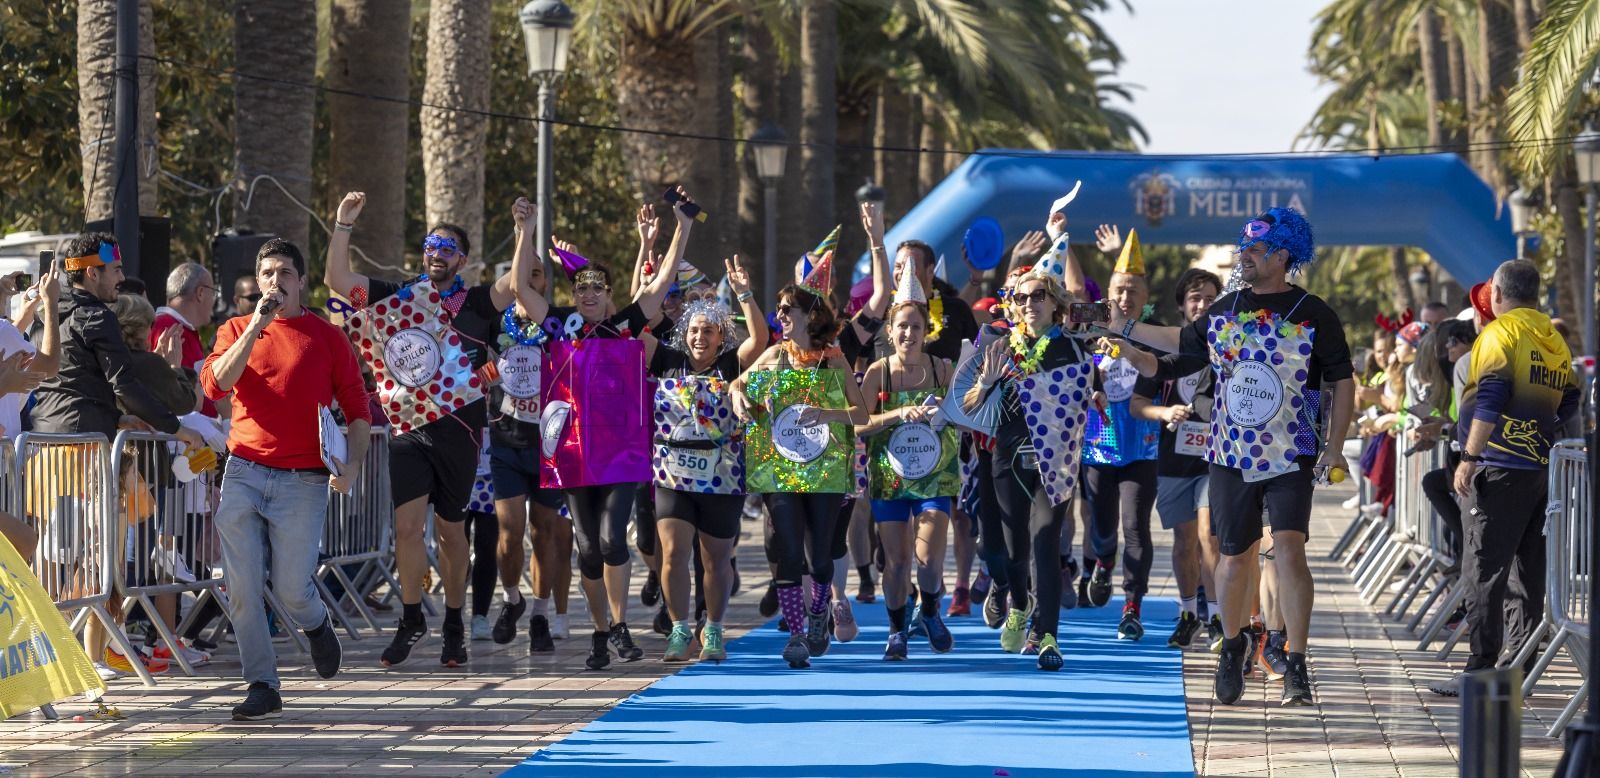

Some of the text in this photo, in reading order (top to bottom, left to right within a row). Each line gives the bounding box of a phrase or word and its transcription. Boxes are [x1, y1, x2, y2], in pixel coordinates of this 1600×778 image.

[1188, 192, 1308, 217] MELILLA
[401, 343, 412, 353] KIT
[1244, 376, 1259, 385] KIT
[677, 454, 708, 471] 550
